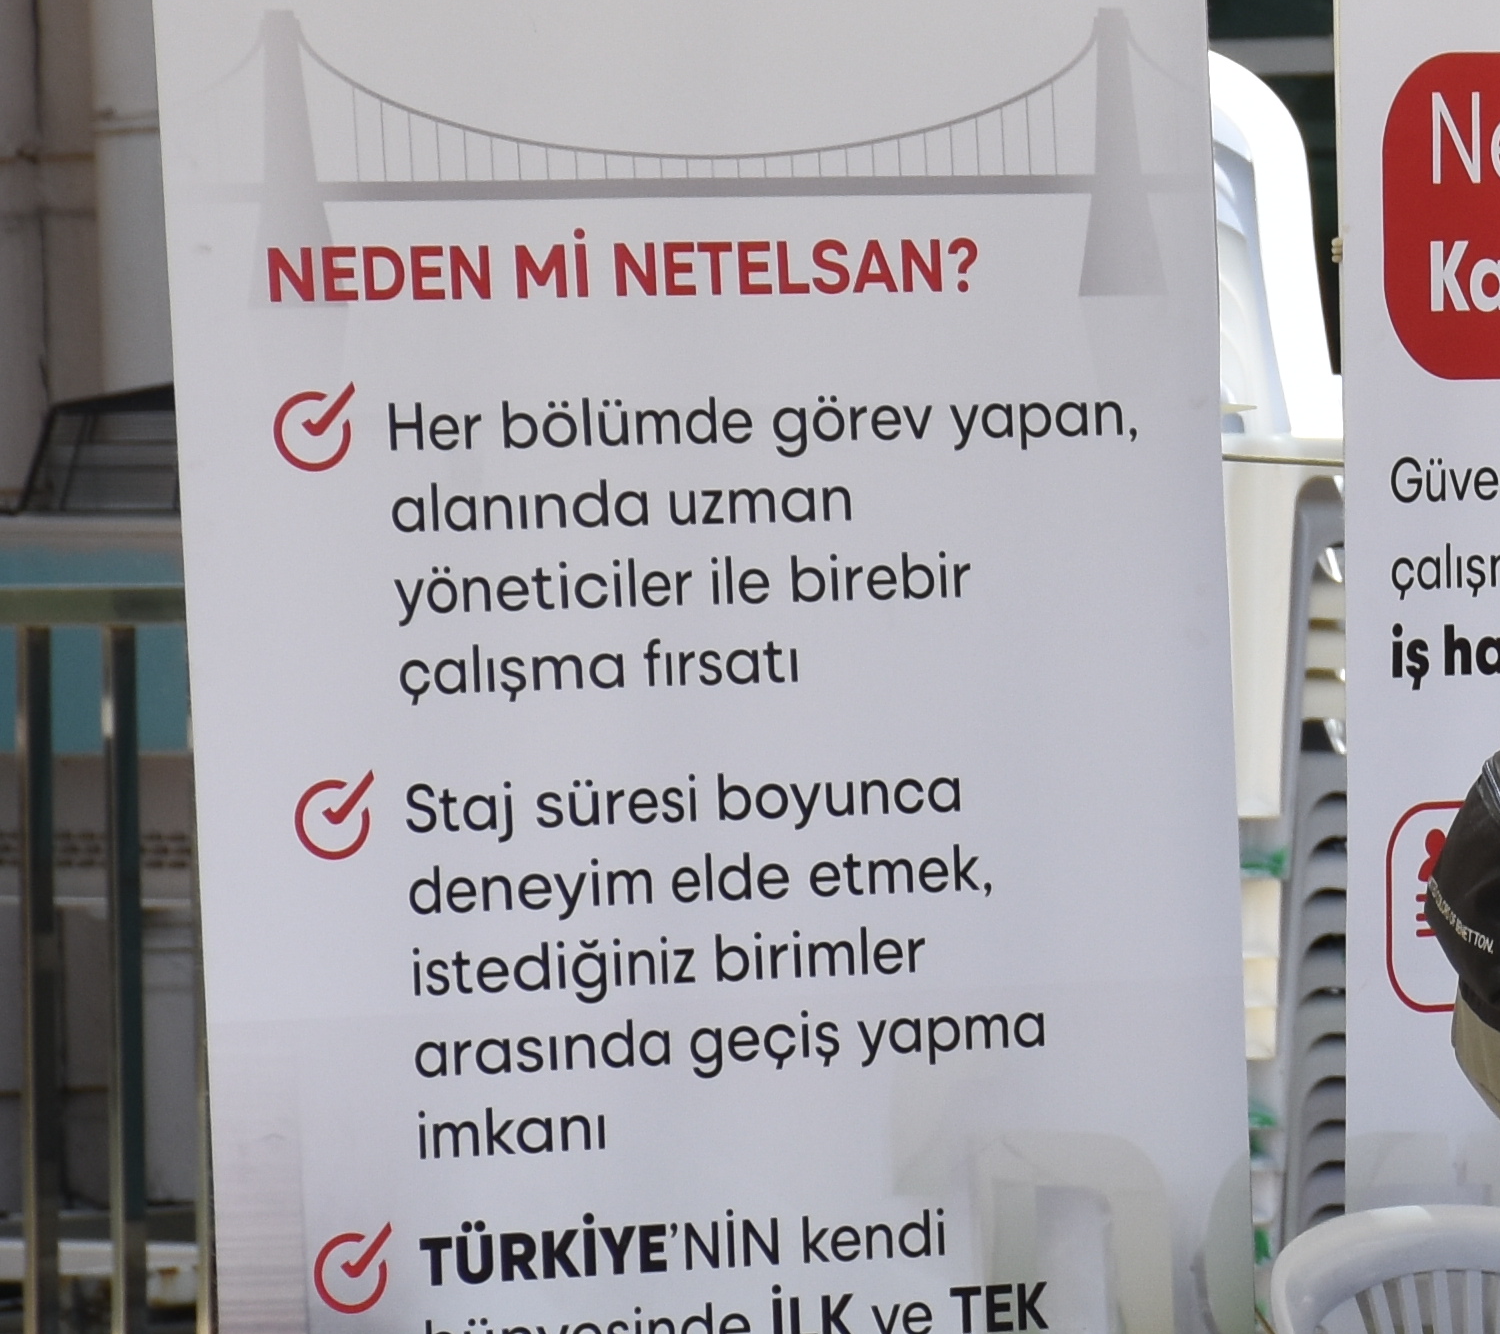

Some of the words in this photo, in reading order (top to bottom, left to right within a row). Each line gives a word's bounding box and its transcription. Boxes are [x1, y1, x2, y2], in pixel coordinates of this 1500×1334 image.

[267, 245, 492, 303] NEDEN
[514, 227, 589, 300] Mİ
[613, 237, 978, 297] NETELSAN?
[388, 401, 482, 451] Her
[501, 395, 753, 450] bölümde
[772, 394, 933, 458] görev
[949, 395, 1138, 451] yapan,
[391, 478, 649, 533] alanında
[669, 482, 852, 526] uzman
[393, 557, 693, 627] yöneticiler
[710, 555, 770, 605] ile
[790, 550, 971, 603] birebir
[399, 643, 625, 706] çalışma
[643, 638, 799, 687] fırsatı
[1392, 622, 1430, 691] iş
[405, 783, 514, 844] Staj
[536, 773, 697, 829] süresi
[717, 767, 961, 831] boyunca
[409, 859, 653, 921] deneyim
[671, 853, 790, 904] elde
[809, 845, 992, 898] etmek,
[412, 935, 696, 1004] istediğiniz
[714, 925, 926, 983] birimler
[414, 1018, 671, 1079] arasında
[690, 1009, 840, 1079] geçiş
[856, 1007, 1045, 1065] yapma
[418, 1110, 606, 1160] imkanı
[419, 1212, 780, 1286] TÜRKİYE'NİN
[801, 1207, 946, 1264] kendi
[949, 1280, 1049, 1334] TEK
